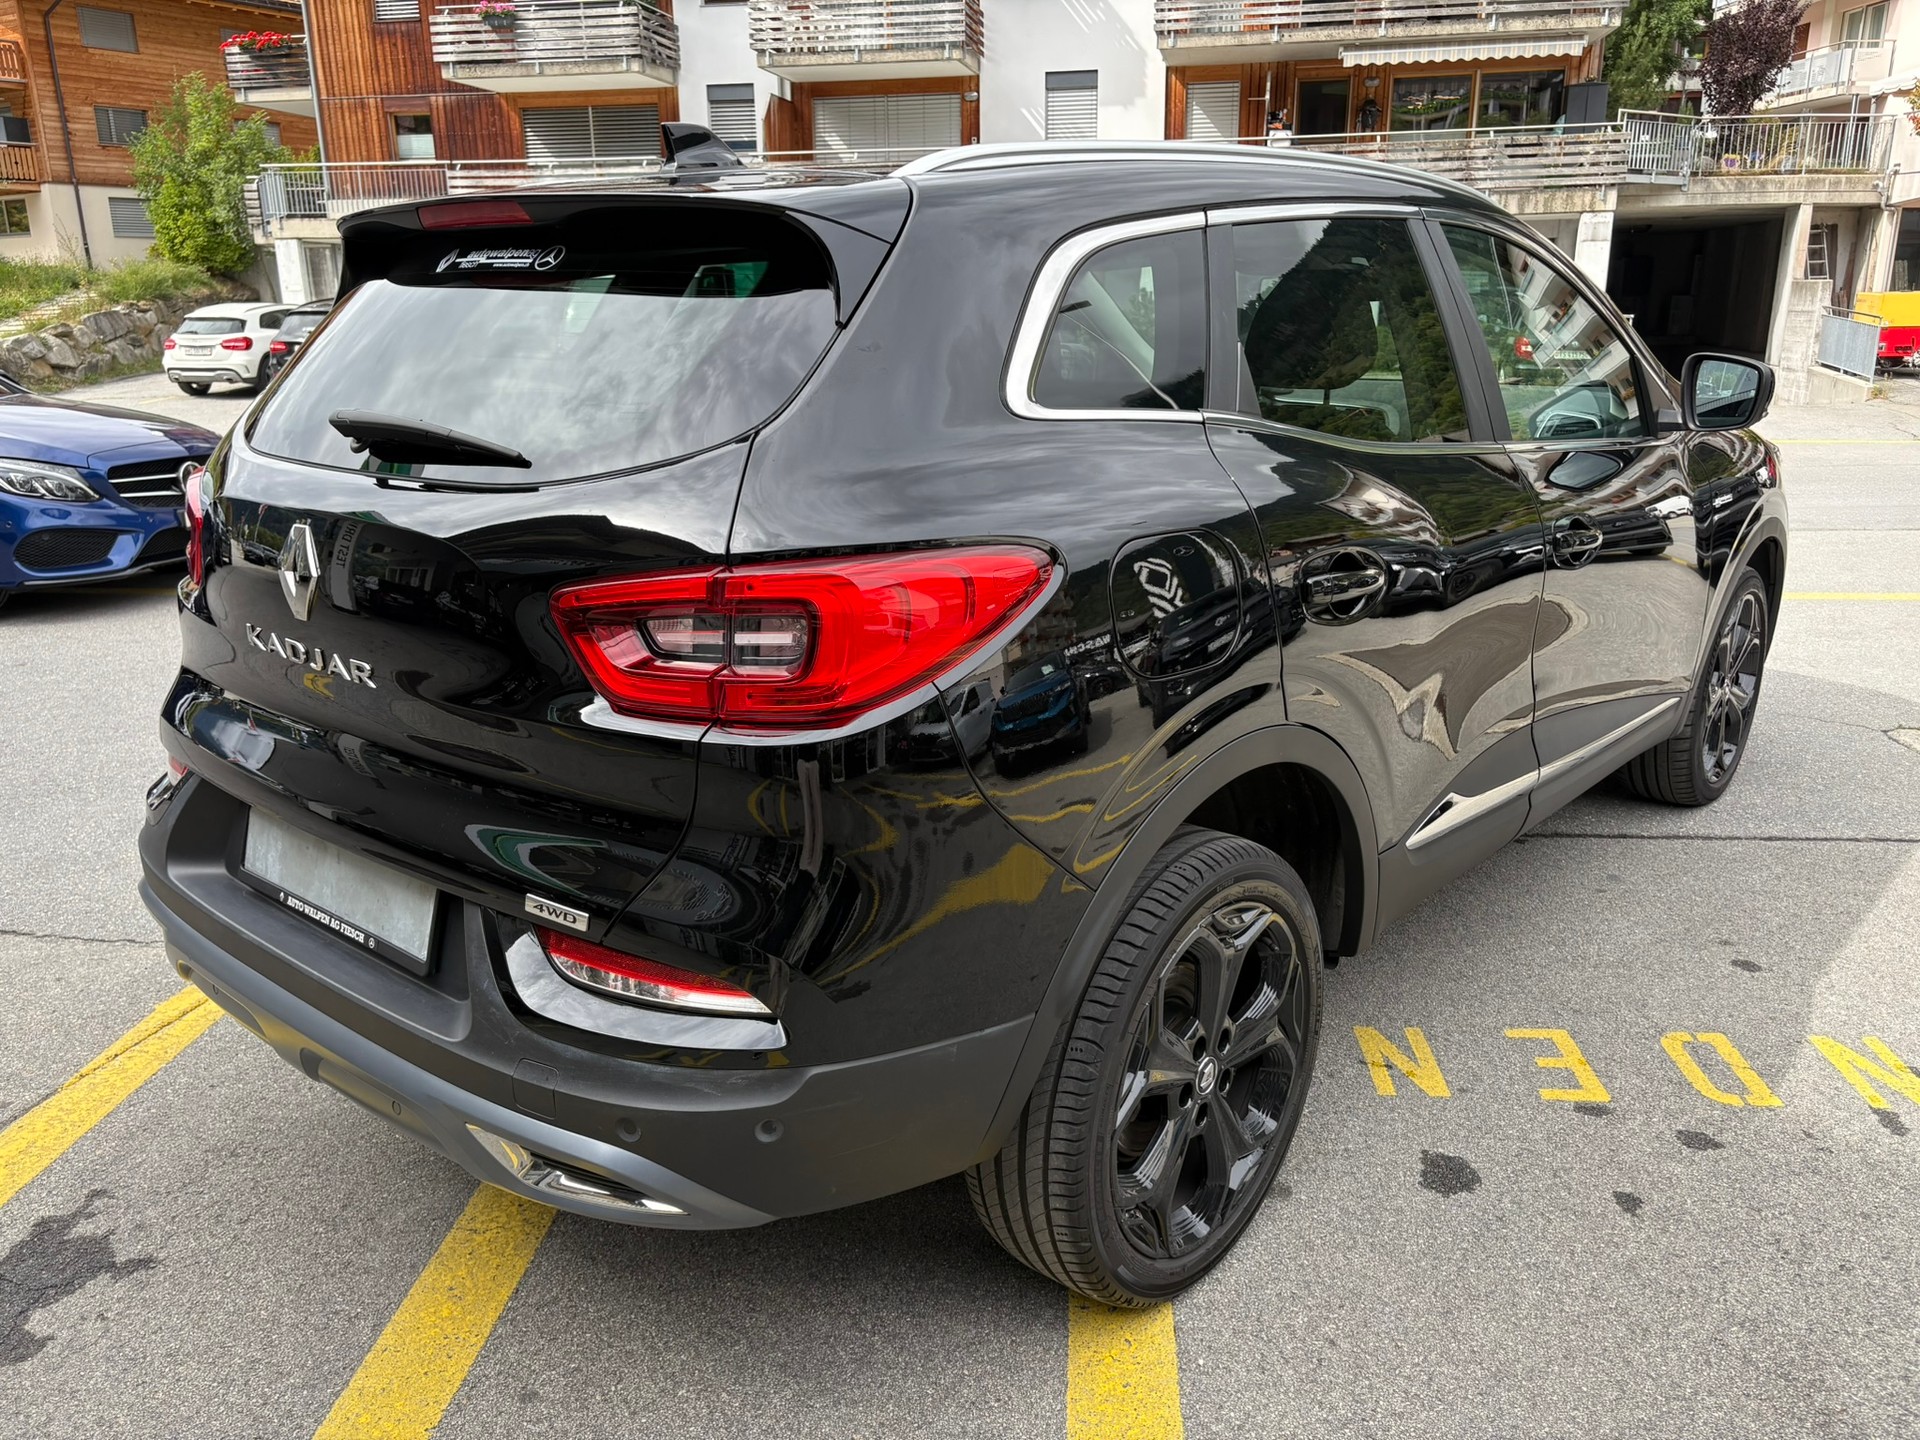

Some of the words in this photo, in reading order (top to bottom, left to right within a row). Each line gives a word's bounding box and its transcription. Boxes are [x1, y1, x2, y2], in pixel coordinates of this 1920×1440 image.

[246, 623, 377, 689] KADJAR
[286, 896, 304, 912] AUTO
[304, 904, 330, 925] WALPEN
[330, 917, 341, 930] AG
[340, 922, 365, 943] FIESCH
[533, 903, 577, 924] 4WD
